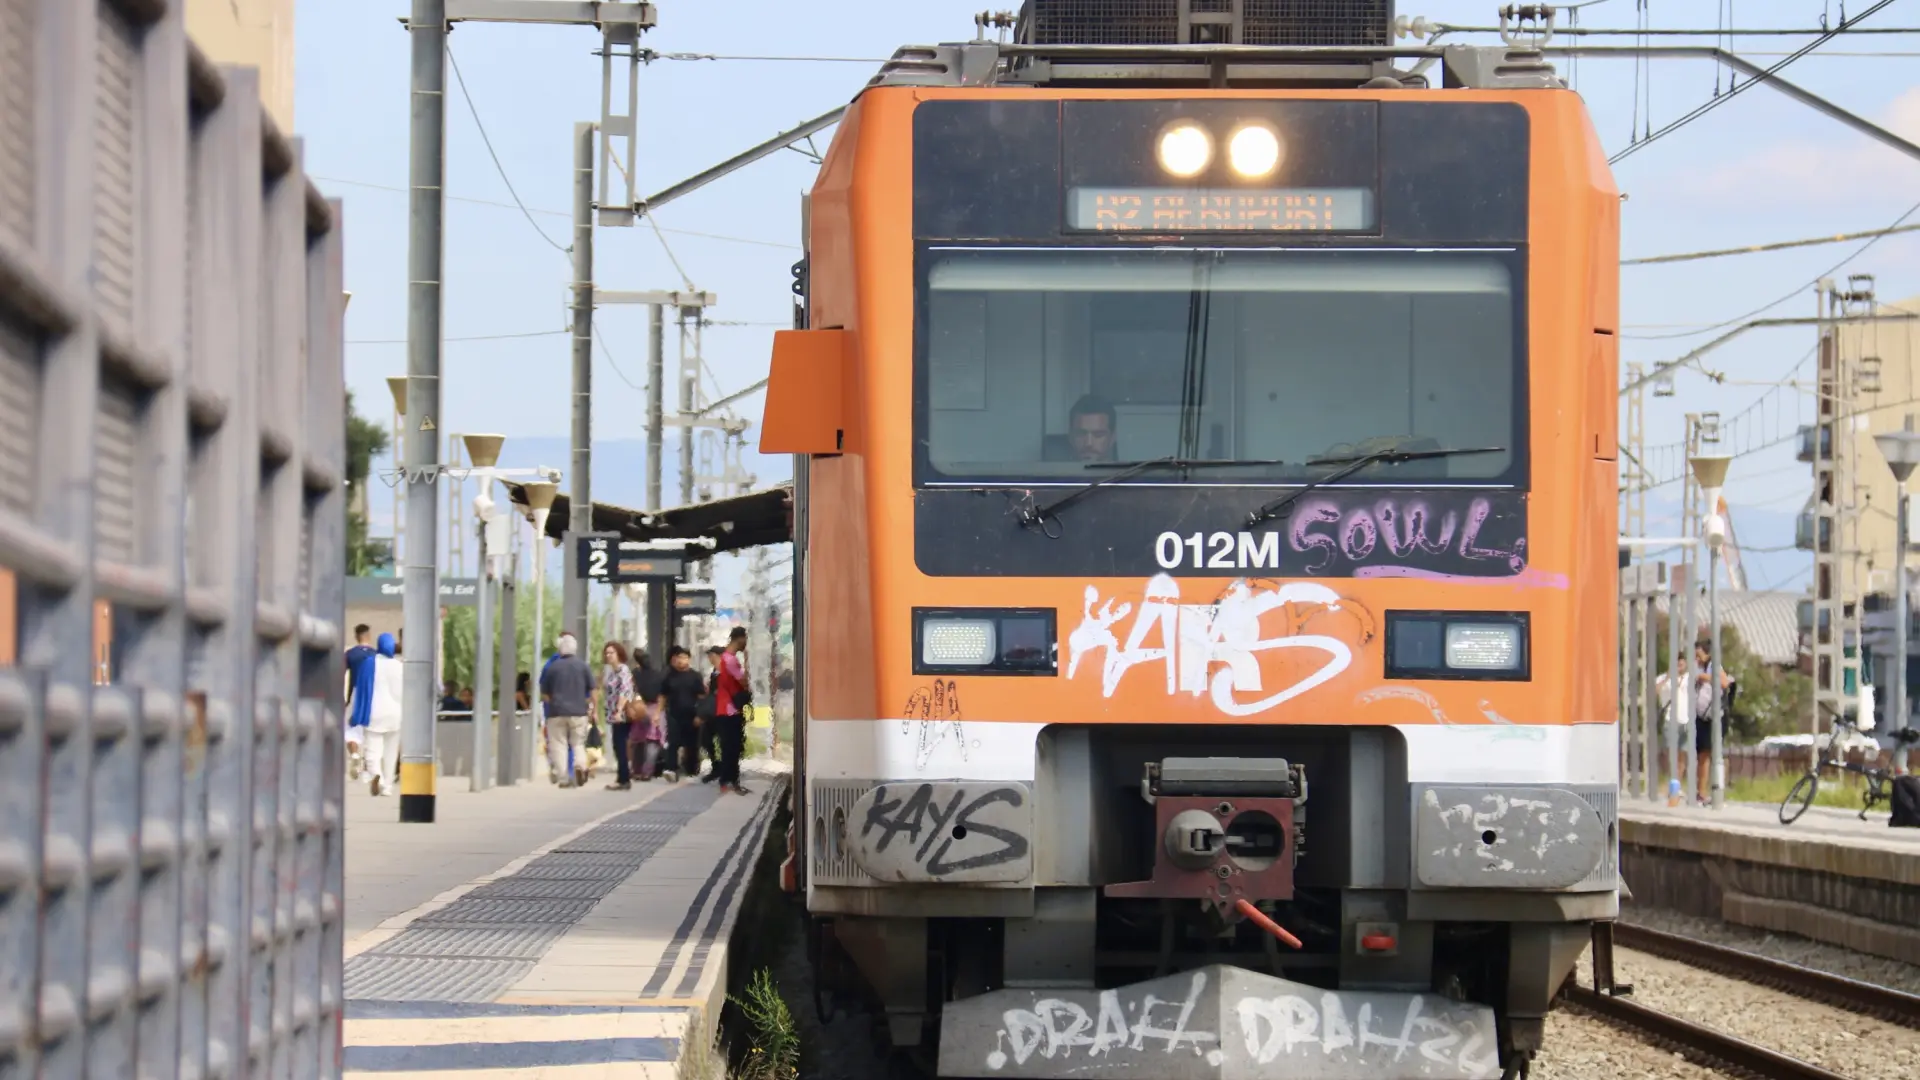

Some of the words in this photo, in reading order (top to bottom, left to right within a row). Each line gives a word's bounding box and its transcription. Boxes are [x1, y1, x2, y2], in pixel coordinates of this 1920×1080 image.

[588, 550, 608, 575] 2
[1155, 531, 1279, 569] 012M
[861, 783, 1028, 875] KAYS
